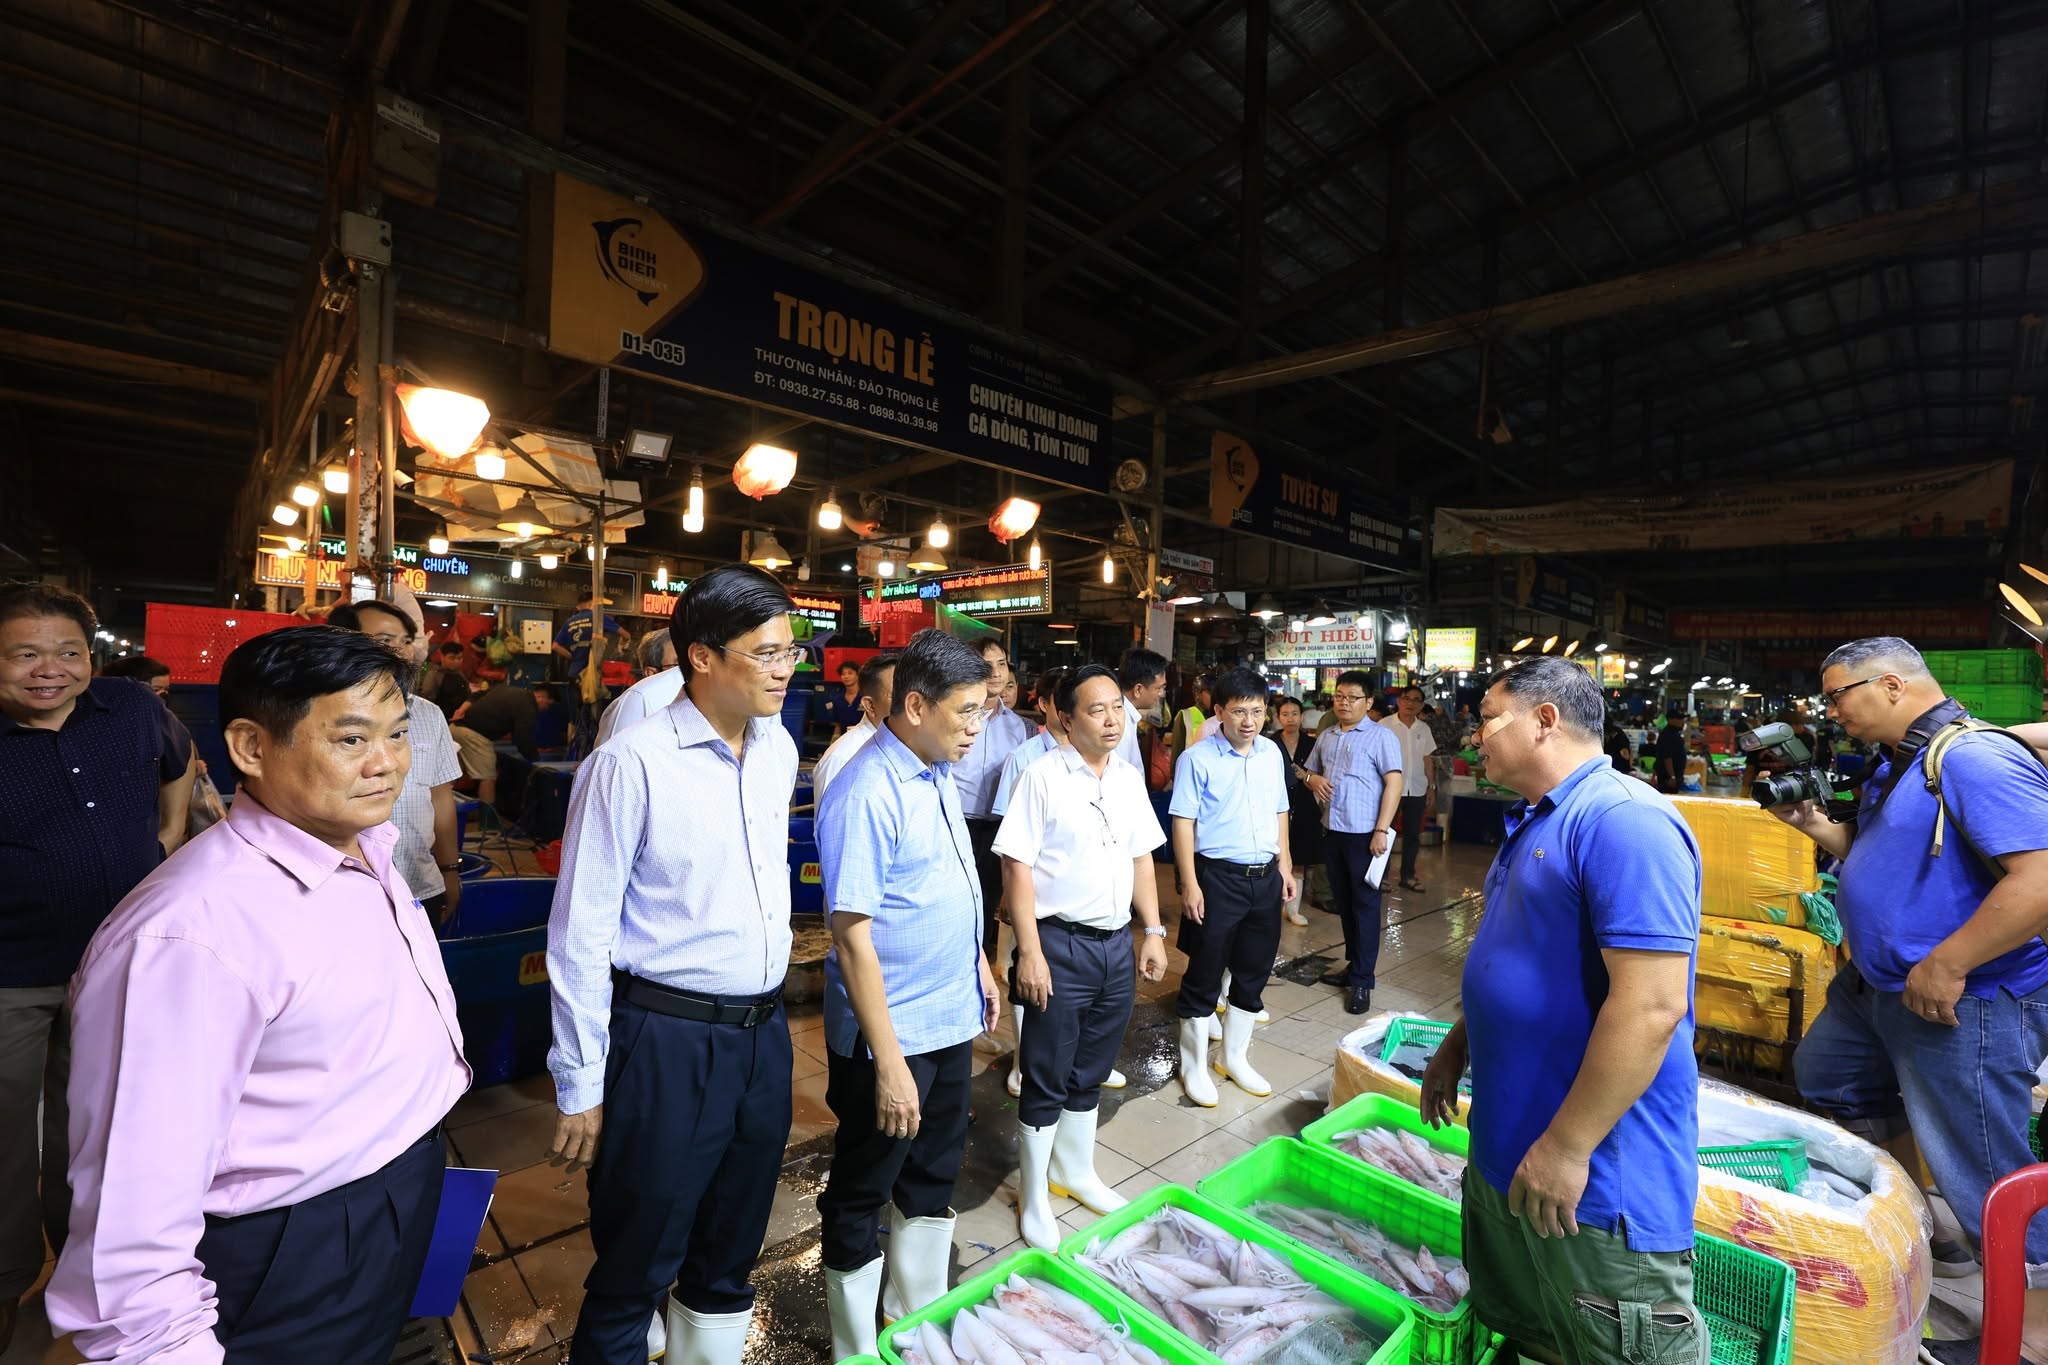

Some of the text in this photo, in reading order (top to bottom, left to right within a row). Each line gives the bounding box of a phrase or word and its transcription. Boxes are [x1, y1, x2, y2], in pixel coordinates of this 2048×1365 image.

[621, 330, 686, 366] D1-035
[772, 289, 897, 375] TRỌNG
[753, 346, 816, 377] THƯƠNG
[818, 364, 857, 388] NHÂN:
[859, 378, 884, 396] ĐÀO
[886, 387, 924, 409] TRỌNG
[753, 370, 776, 388] ĐT:
[779, 378, 860, 411] 0938.27.55.88
[868, 403, 940, 433] 0898.30.39.98
[968, 411, 989, 438] CÁ
[1032, 431, 1060, 459] TÔM
[1062, 440, 1090, 467] TƯƠI
[969, 383, 1024, 420] CHUYÊN
[1025, 401, 1057, 431] KINH
[1058, 412, 1099, 443] DOANH
[319, 541, 347, 556] THỦ
